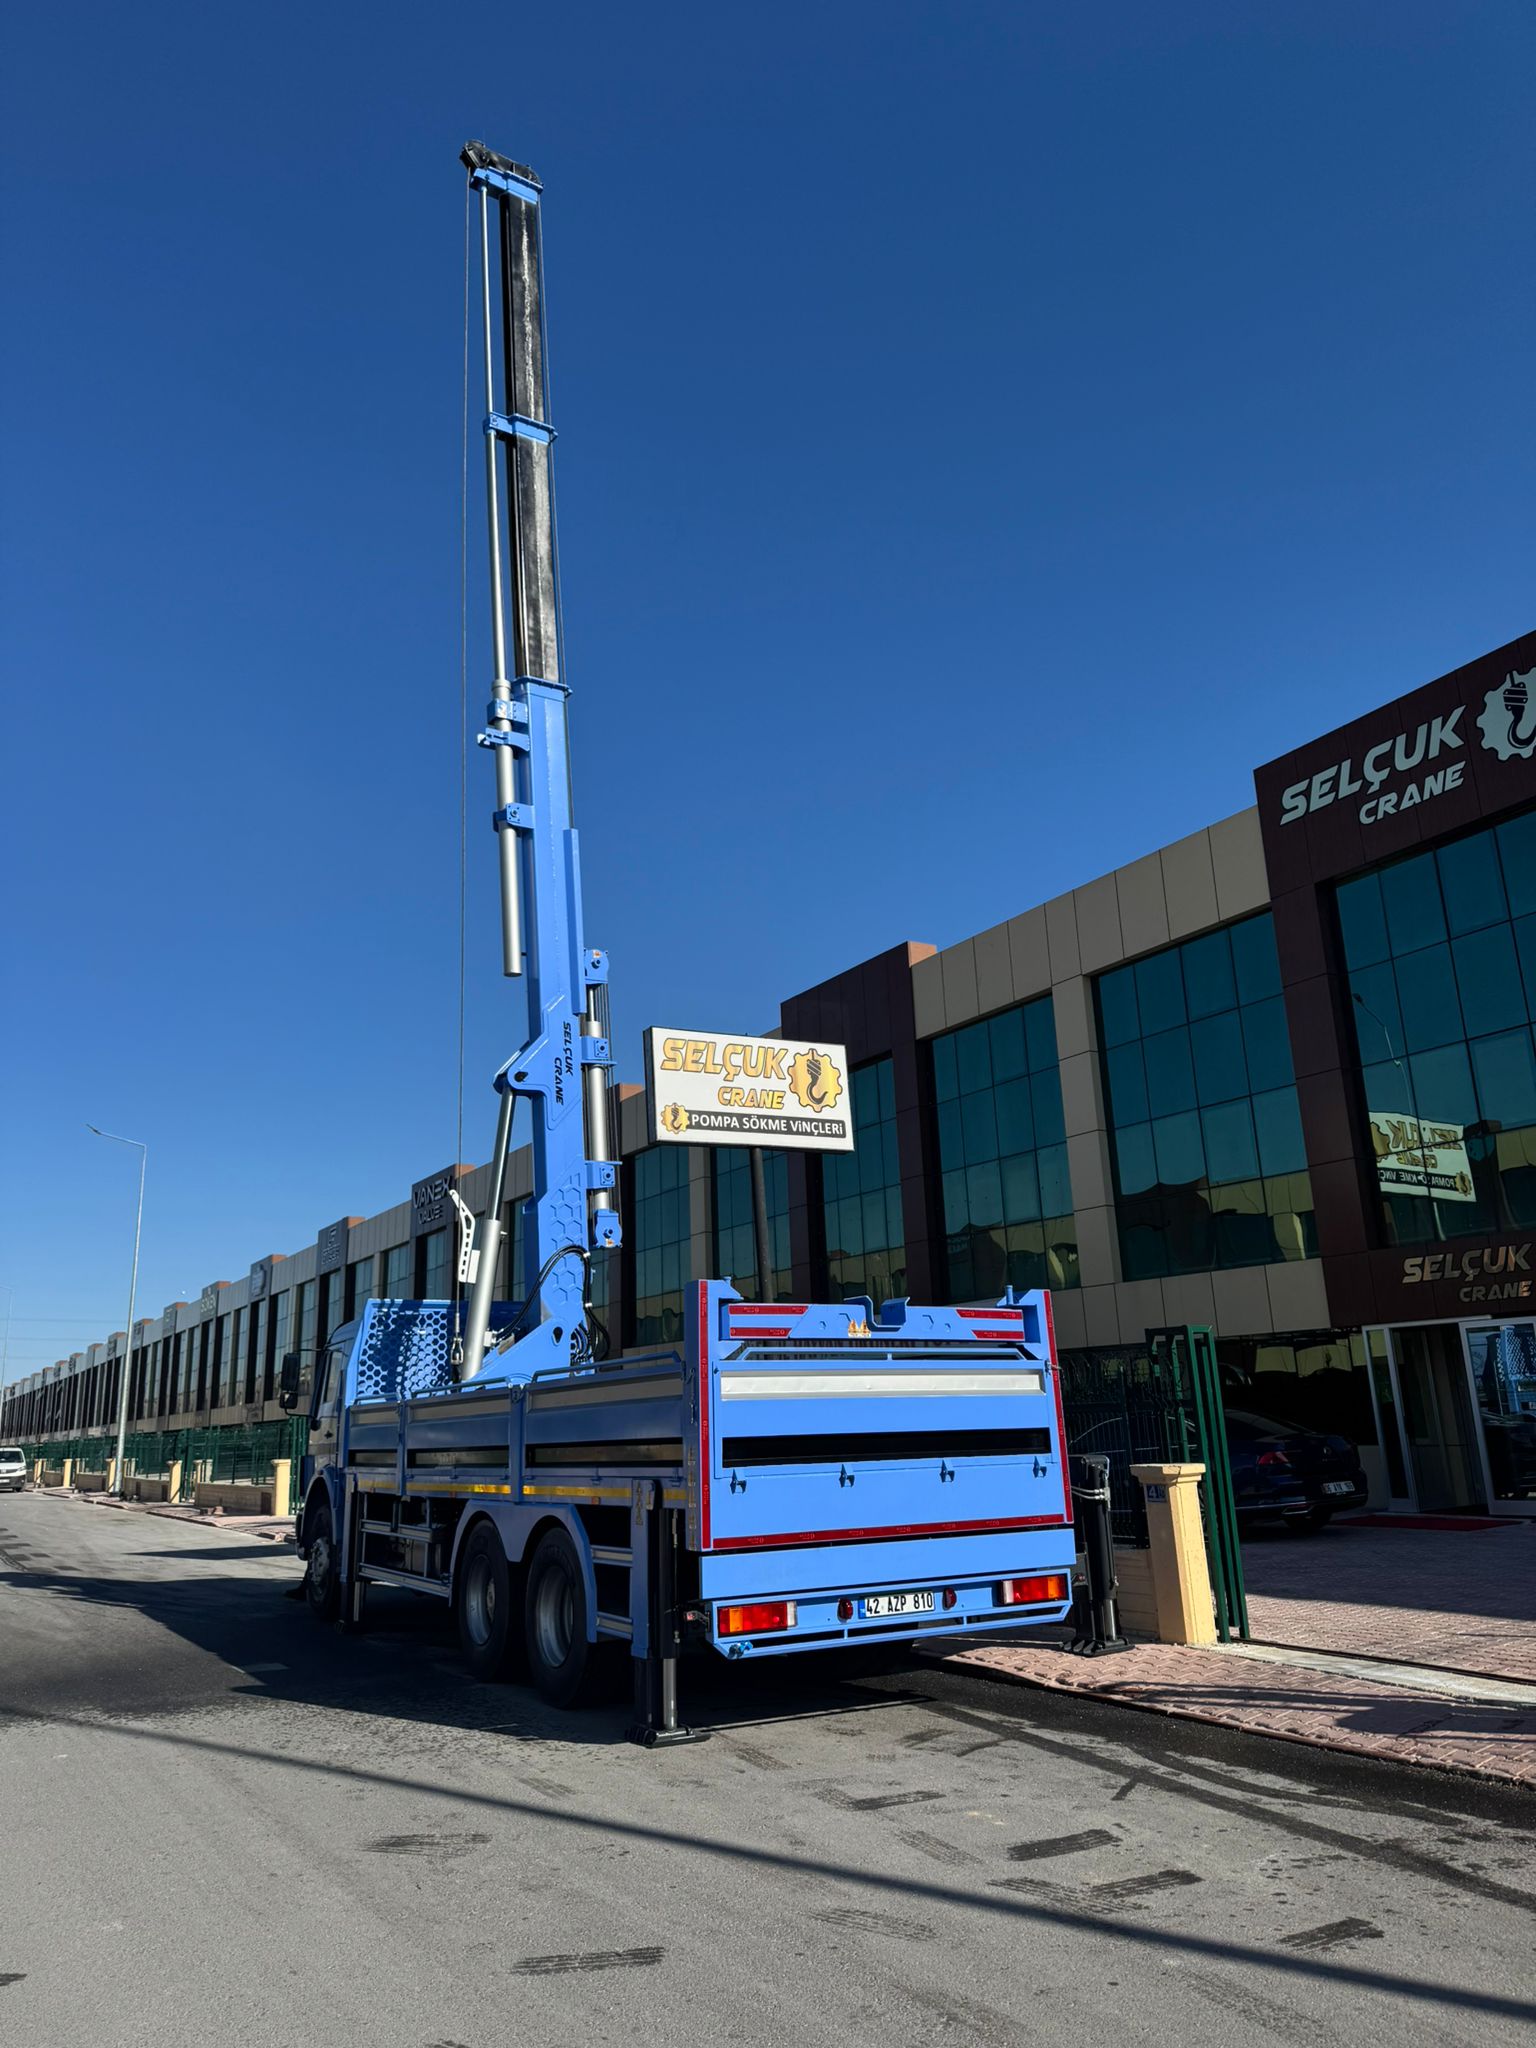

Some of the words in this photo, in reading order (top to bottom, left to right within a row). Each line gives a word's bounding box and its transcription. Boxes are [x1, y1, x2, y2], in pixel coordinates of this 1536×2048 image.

[1280, 704, 1467, 826] SELÇUK
[1359, 761, 1466, 825] CRANE
[562, 1021, 574, 1077] SELÇUK
[660, 1037, 788, 1082] SELÇUK
[554, 1057, 564, 1106] CRANE
[717, 1086, 786, 1110] CRANE
[691, 1115, 740, 1129] POMPA
[744, 1115, 788, 1132] SÖKME
[412, 1175, 450, 1209] VANEX
[1402, 1243, 1533, 1284] SELÇUK
[1459, 1280, 1533, 1303] CRANE
[866, 1598, 881, 1615] 42
[887, 1595, 907, 1613] AZP
[913, 1592, 933, 1610] 810
